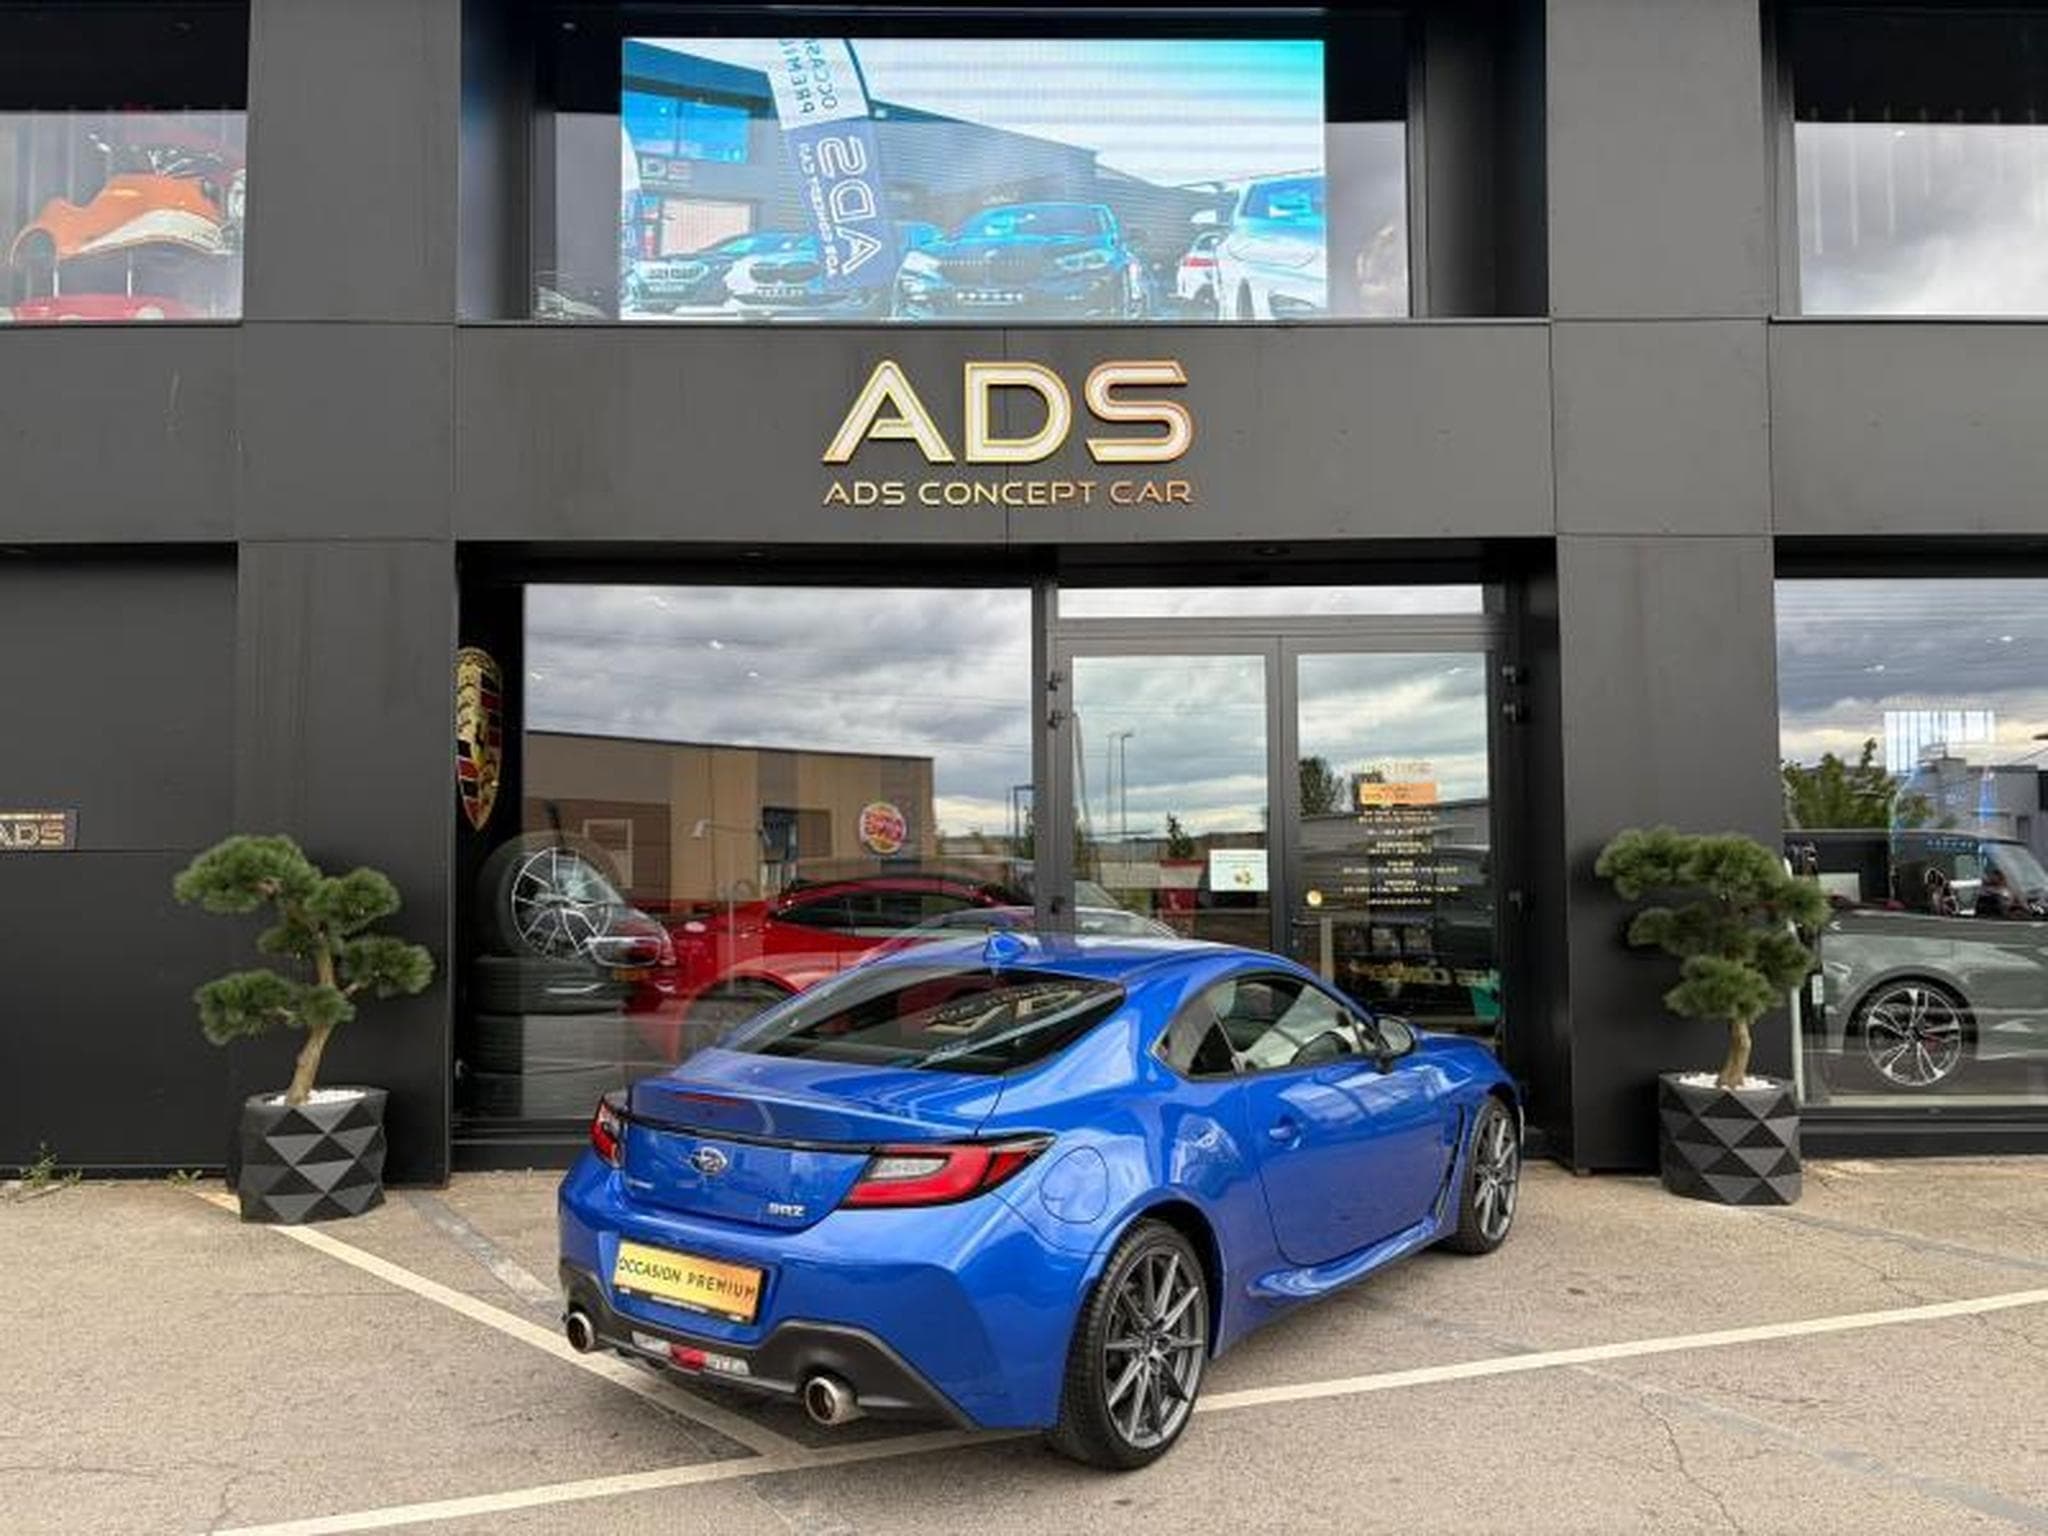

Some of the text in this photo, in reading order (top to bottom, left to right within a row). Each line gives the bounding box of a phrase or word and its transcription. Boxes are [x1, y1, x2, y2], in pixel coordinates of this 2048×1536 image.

[822, 359, 1194, 463] ADS
[823, 480, 1194, 505] ADS CONCEPT CAR
[619, 1257, 757, 1302] OCCASION PREMIUM
